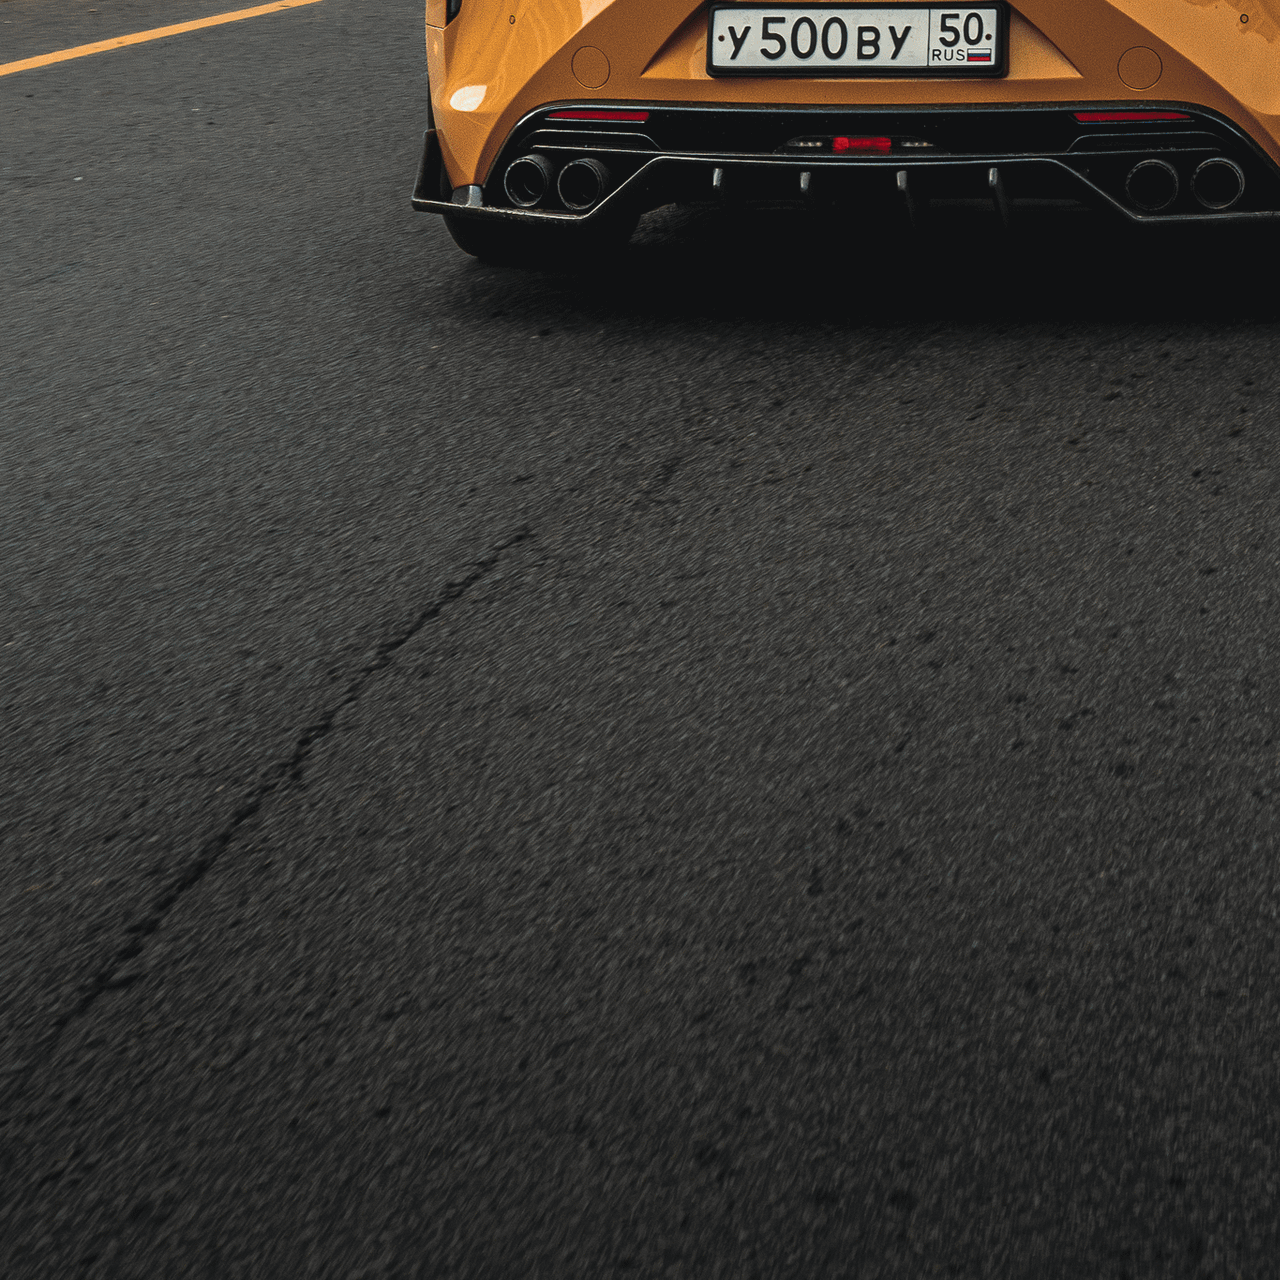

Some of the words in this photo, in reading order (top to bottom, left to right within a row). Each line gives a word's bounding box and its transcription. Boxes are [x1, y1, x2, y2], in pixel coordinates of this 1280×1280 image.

[727, 16, 912, 61] У500ВУ
[938, 11, 984, 48] 50
[931, 48, 965, 61] RUS
